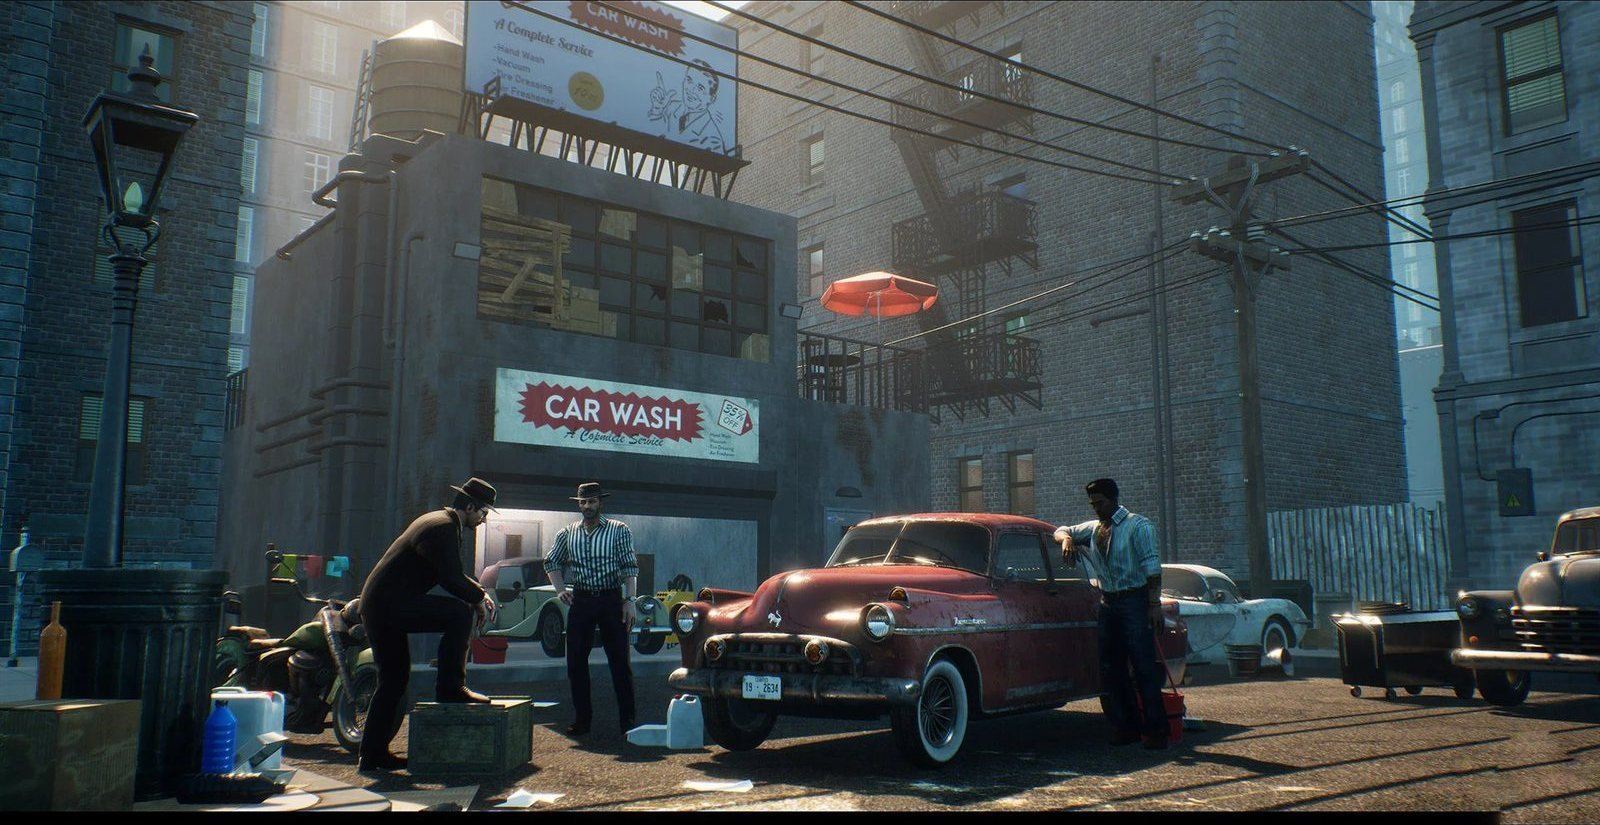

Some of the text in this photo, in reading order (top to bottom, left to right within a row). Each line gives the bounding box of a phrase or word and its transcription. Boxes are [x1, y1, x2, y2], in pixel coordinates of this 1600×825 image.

[587, 2, 668, 40] CAR WASH
[507, 20, 556, 46] Complete
[557, 36, 594, 59] Service
[545, 395, 682, 431] CAR WASH
[723, 404, 745, 421] 35%
[723, 416, 739, 428] OFF
[628, 433, 665, 447] Service
[745, 682, 753, 692] 19
[763, 683, 779, 693] 2634
